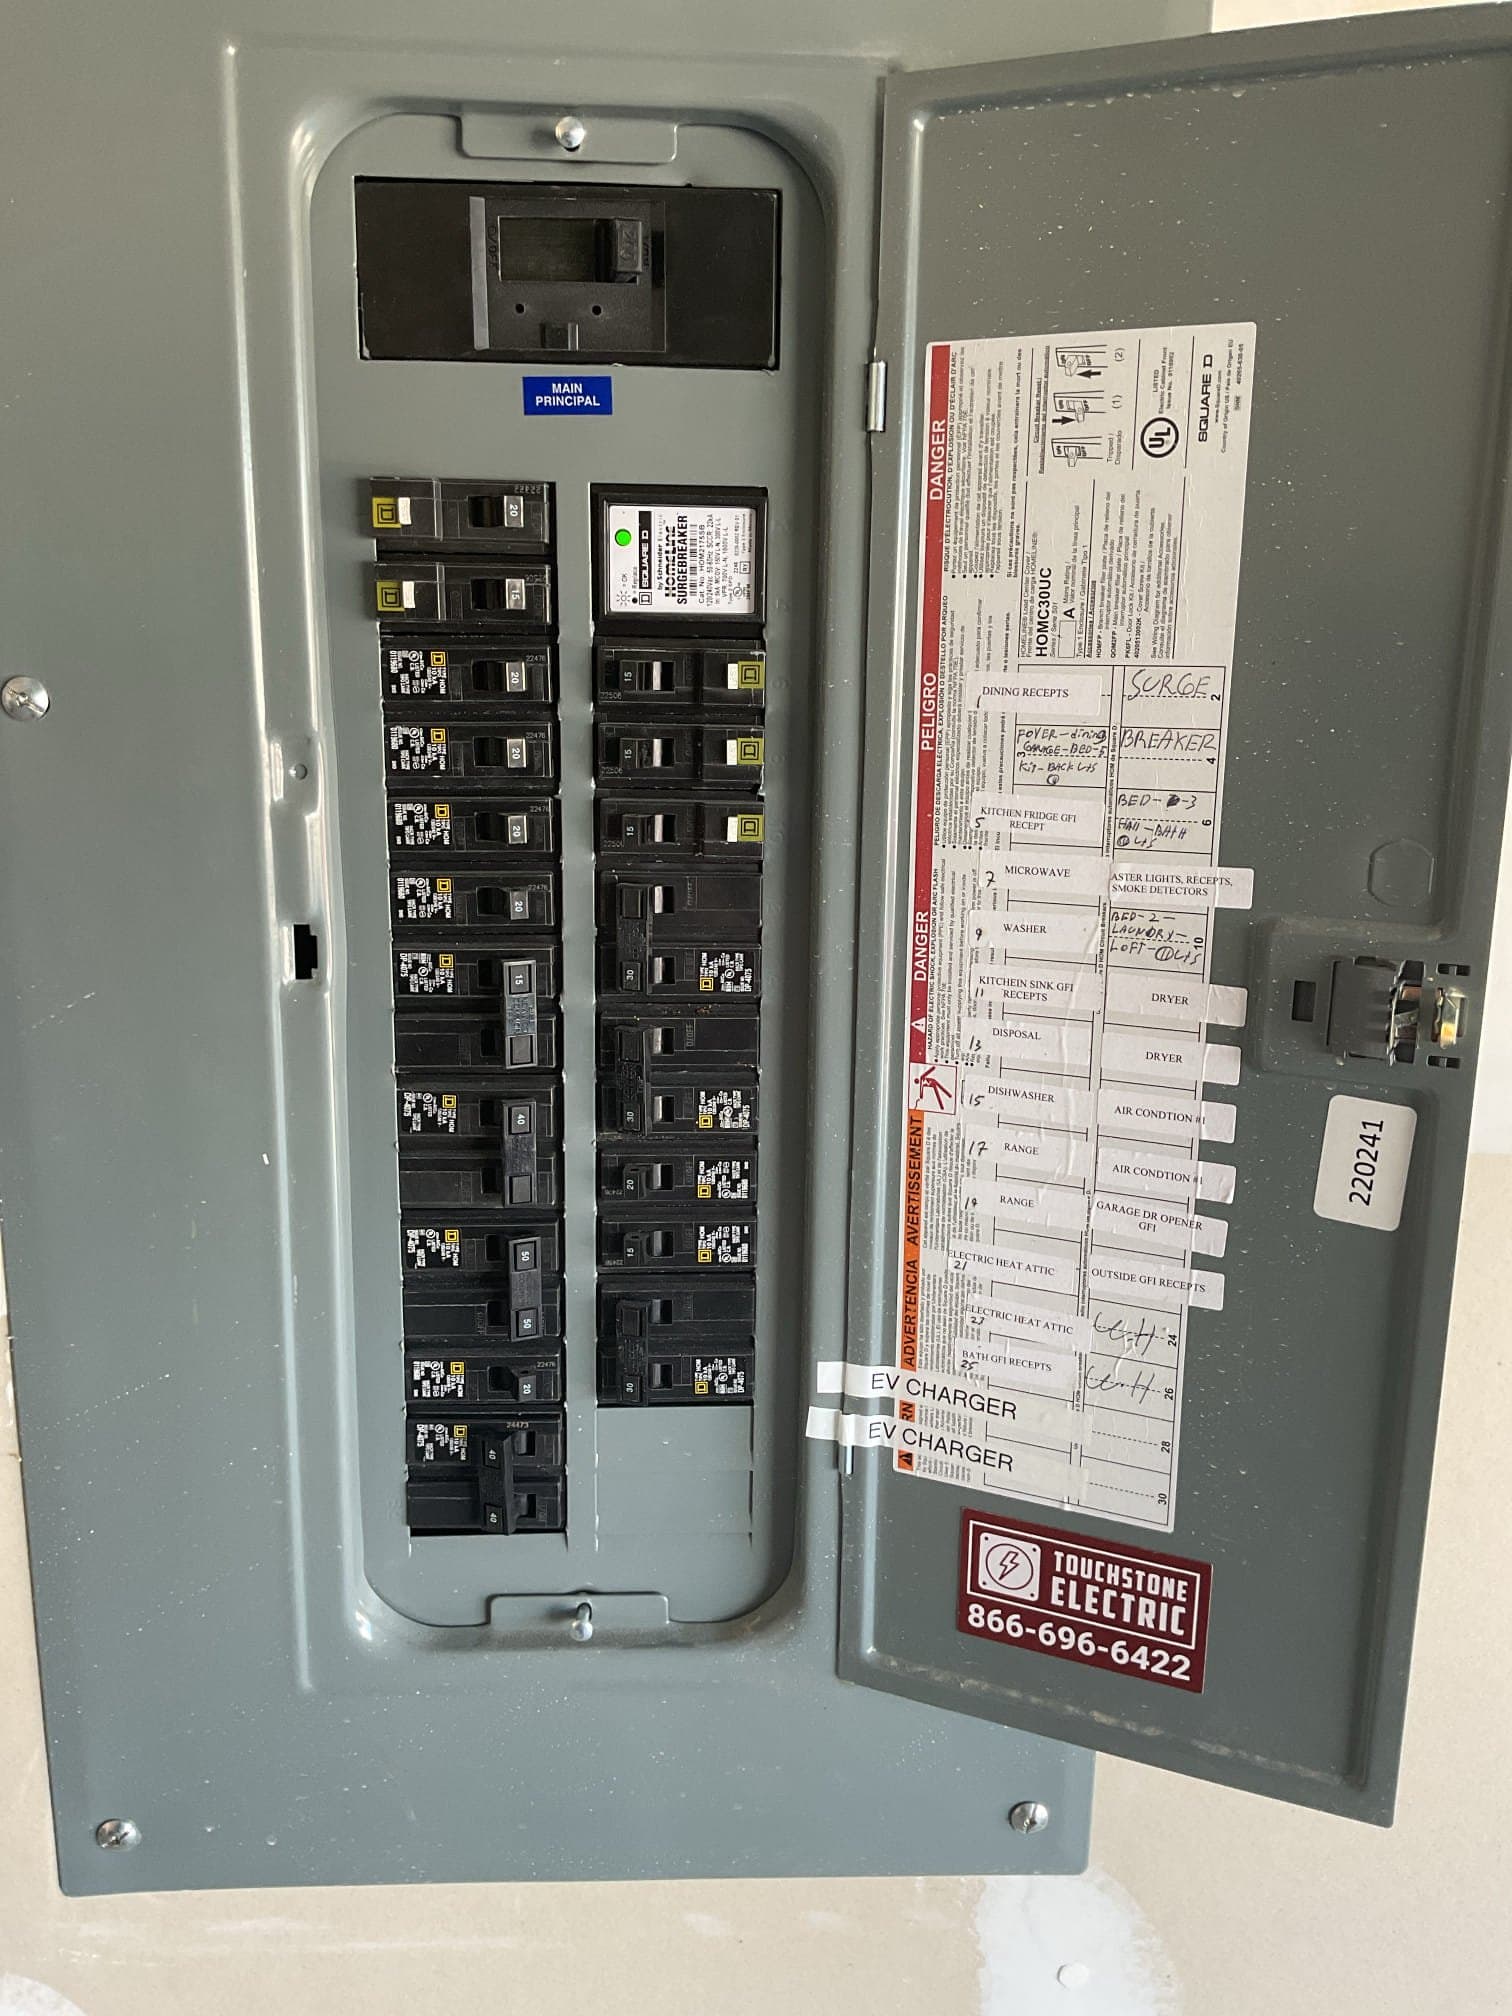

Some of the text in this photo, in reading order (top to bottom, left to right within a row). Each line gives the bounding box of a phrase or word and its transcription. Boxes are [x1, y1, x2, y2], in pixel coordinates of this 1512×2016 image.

[1114, 348, 1125, 362] (2)
[1152, 369, 1160, 393] LISTED
[551, 383, 583, 394] MAIN
[535, 395, 600, 406] PRINCIPAL
[1111, 395, 1122, 409] (1)
[1198, 354, 1212, 442] SQUARE D
[1148, 427, 1171, 448] UL
[930, 419, 946, 500] DANGER
[510, 504, 517, 516] 20
[642, 530, 648, 539] D
[677, 515, 687, 604] SURGEBREAKER
[658, 582, 663, 590] by
[512, 589, 519, 600] 15
[1036, 567, 1052, 657] HOMC30UC
[1063, 608, 1075, 619] A
[512, 672, 519, 683] 20
[624, 671, 632, 682] 15
[1127, 669, 1212, 701] SURGE
[982, 686, 1069, 698] DINING RECEPTS
[1210, 693, 1221, 701] 2
[921, 672, 937, 751] PELIGRO
[1120, 732, 1216, 751] BREAKER
[512, 748, 520, 759] 20
[625, 749, 632, 759] 15
[980, 806, 1076, 823] KITCHEN FRIDGE GFI
[513, 825, 520, 837] 20
[627, 826, 634, 836] 15
[1009, 821, 1045, 831] RECEPT
[1005, 865, 1071, 878] MICROWAVE
[1145, 874, 1183, 884] LIGHTS,
[1186, 876, 1233, 886] RECEPTS,
[1112, 885, 1208, 896] SMOKE DETECTORS
[515, 901, 523, 912] 20
[1003, 923, 1047, 934] WASHER
[914, 911, 928, 981] DANGER
[1194, 937, 1203, 950] 10
[515, 975, 523, 985] 15
[626, 969, 634, 980] 30
[1029, 978, 1055, 989] SINK
[1057, 981, 1074, 991] GFI
[1003, 989, 1048, 1001] RECEPTS
[1151, 993, 1189, 1005] DRYER
[992, 1027, 1041, 1040] DISPOSAL
[1145, 1051, 1183, 1064] DRYER
[988, 1085, 1055, 1103] DISHWASHER
[517, 1114, 525, 1125] 40
[627, 1111, 634, 1123] 30
[1114, 1105, 1132, 1115] AIR
[1135, 1108, 1193, 1123] CONDTION
[1004, 1143, 1039, 1156] RANGE
[1348, 1120, 1384, 1206] 220241
[1112, 1164, 1132, 1174] AIR
[1134, 1166, 1191, 1183] CONDTION
[627, 1179, 634, 1190] 20
[907, 1116, 922, 1246] AVERTISSEMENT
[1000, 1195, 1034, 1208] RANGE
[1096, 1200, 1203, 1230] GARAGE DR OPENER
[1138, 1221, 1156, 1233] GFI
[521, 1251, 530, 1261] 50
[627, 1248, 634, 1257] 15
[948, 1250, 1055, 1276] ELECTRIC HEAT ATTIC
[1092, 1268, 1207, 1293] OUTSIDE GFI RECEPTS
[904, 1259, 917, 1367] ADVERTENCIA
[523, 1319, 531, 1329] 50
[965, 1305, 1073, 1335] ELECTRIC HEAT ATTIC
[1168, 1334, 1177, 1347] 24
[962, 1350, 1052, 1372] BATH GFI RECEPTS
[523, 1384, 531, 1394] 20
[626, 1383, 634, 1393] 30
[1164, 1388, 1174, 1400] 26
[872, 1373, 900, 1390] EV
[906, 1379, 1017, 1420] CHARGER
[869, 1422, 896, 1439] EV
[903, 1428, 1013, 1472] CHARGER
[1161, 1440, 1171, 1453] 28
[489, 1449, 496, 1460] 40
[1157, 1493, 1168, 1505] 30
[489, 1512, 497, 1523] 40
[1053, 1551, 1188, 1602] TOUCHSTONE
[1050, 1576, 1186, 1636] ELECTRIC
[967, 1604, 1191, 1681] 866-696-6422
